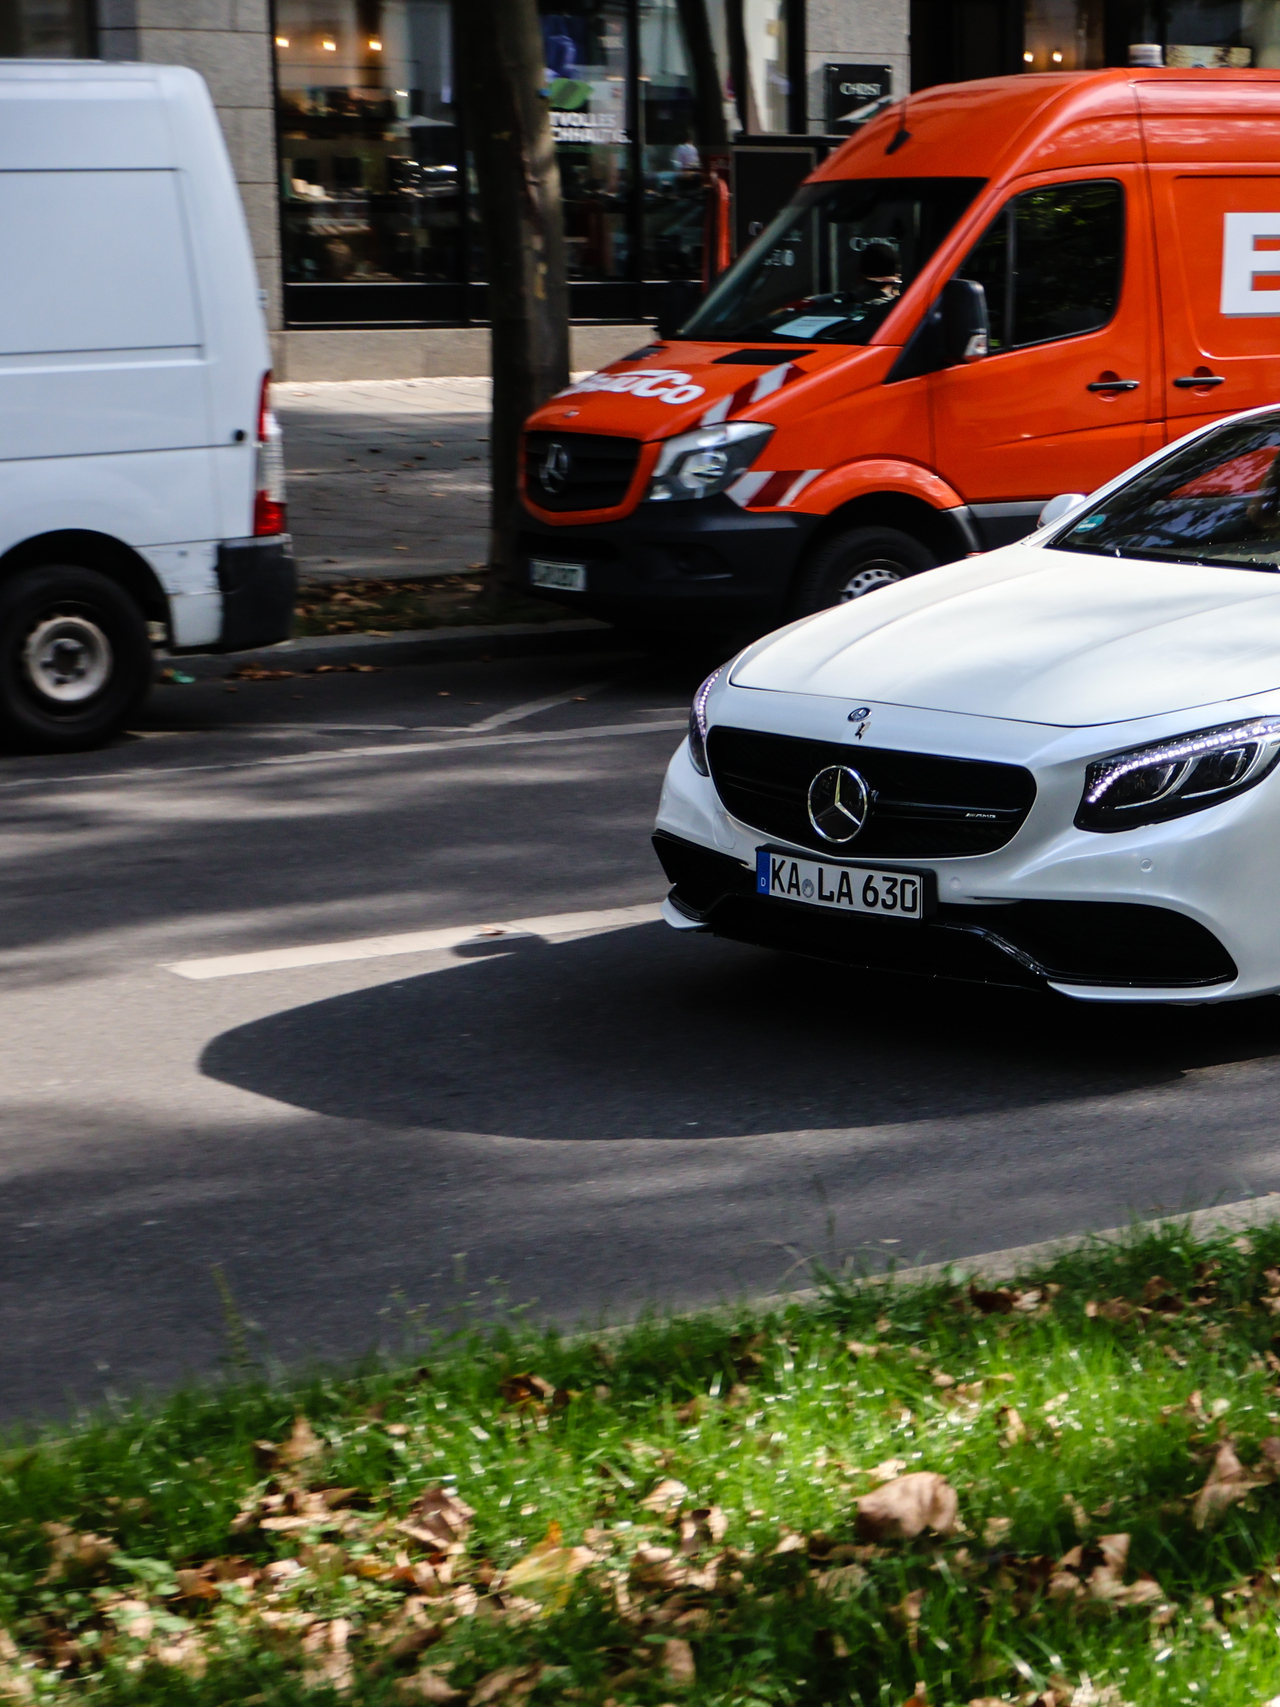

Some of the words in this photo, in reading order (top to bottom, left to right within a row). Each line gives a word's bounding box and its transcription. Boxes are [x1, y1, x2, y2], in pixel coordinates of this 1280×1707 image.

[771, 857, 801, 896] KA
[817, 867, 854, 905] LA
[862, 874, 918, 913] 630
